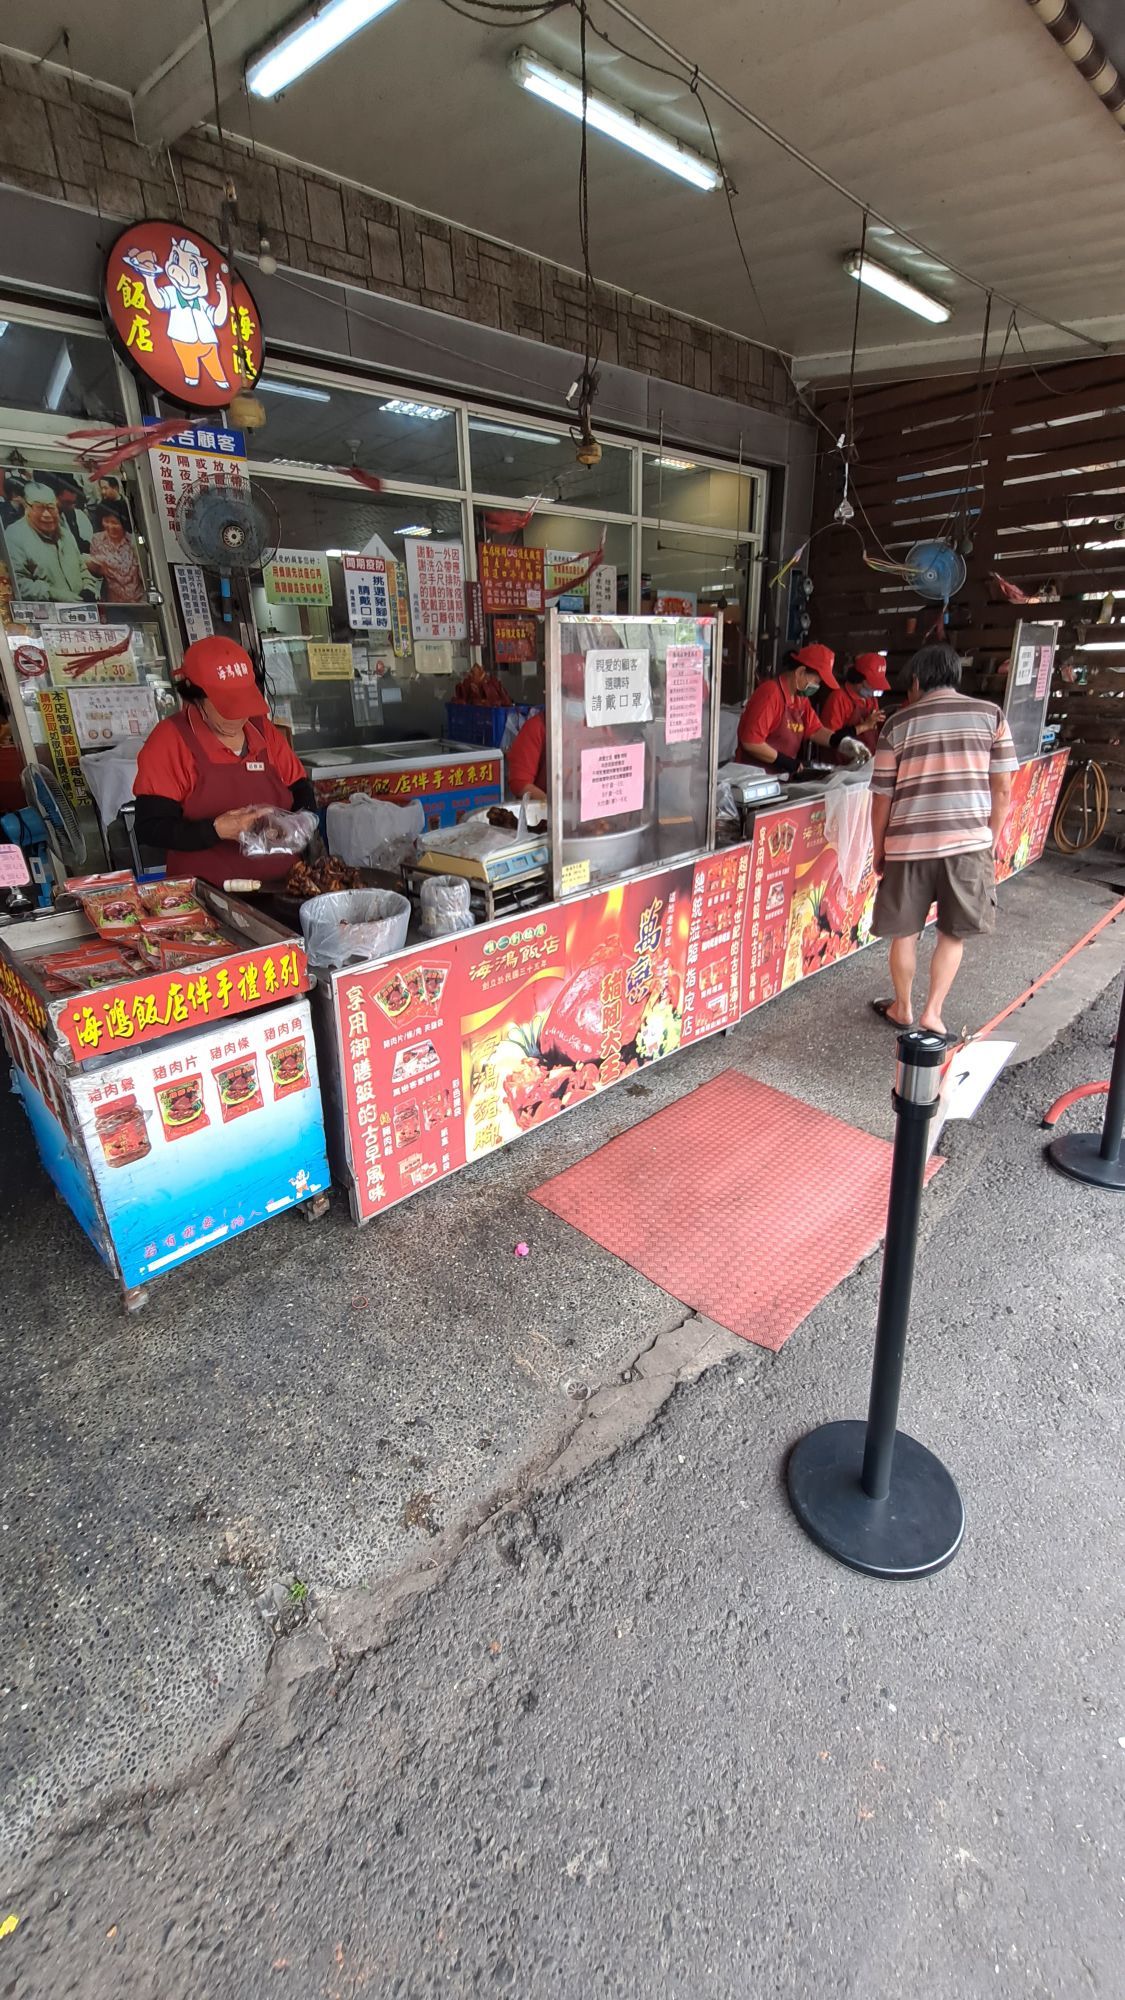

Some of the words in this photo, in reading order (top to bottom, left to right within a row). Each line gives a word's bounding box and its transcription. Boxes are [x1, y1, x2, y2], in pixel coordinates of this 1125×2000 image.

[116, 273, 154, 353] 飯店
[161, 428, 236, 452] 告顧客
[59, 630, 118, 643] 用餐時間
[595, 658, 639, 672] 親愛的顧客
[605, 676, 630, 690] 選購時
[591, 692, 642, 711] 請戴口罩
[468, 935, 560, 981] 海鴻飯店
[71, 951, 301, 1048] 海鴻飯店伴手禮系列
[263, 1017, 303, 1043] 豬肉角
[209, 1036, 251, 1060] 豬肉條
[152, 1054, 199, 1080] 豬肉片
[345, 985, 386, 1204] 享用御膳級的古早風味
